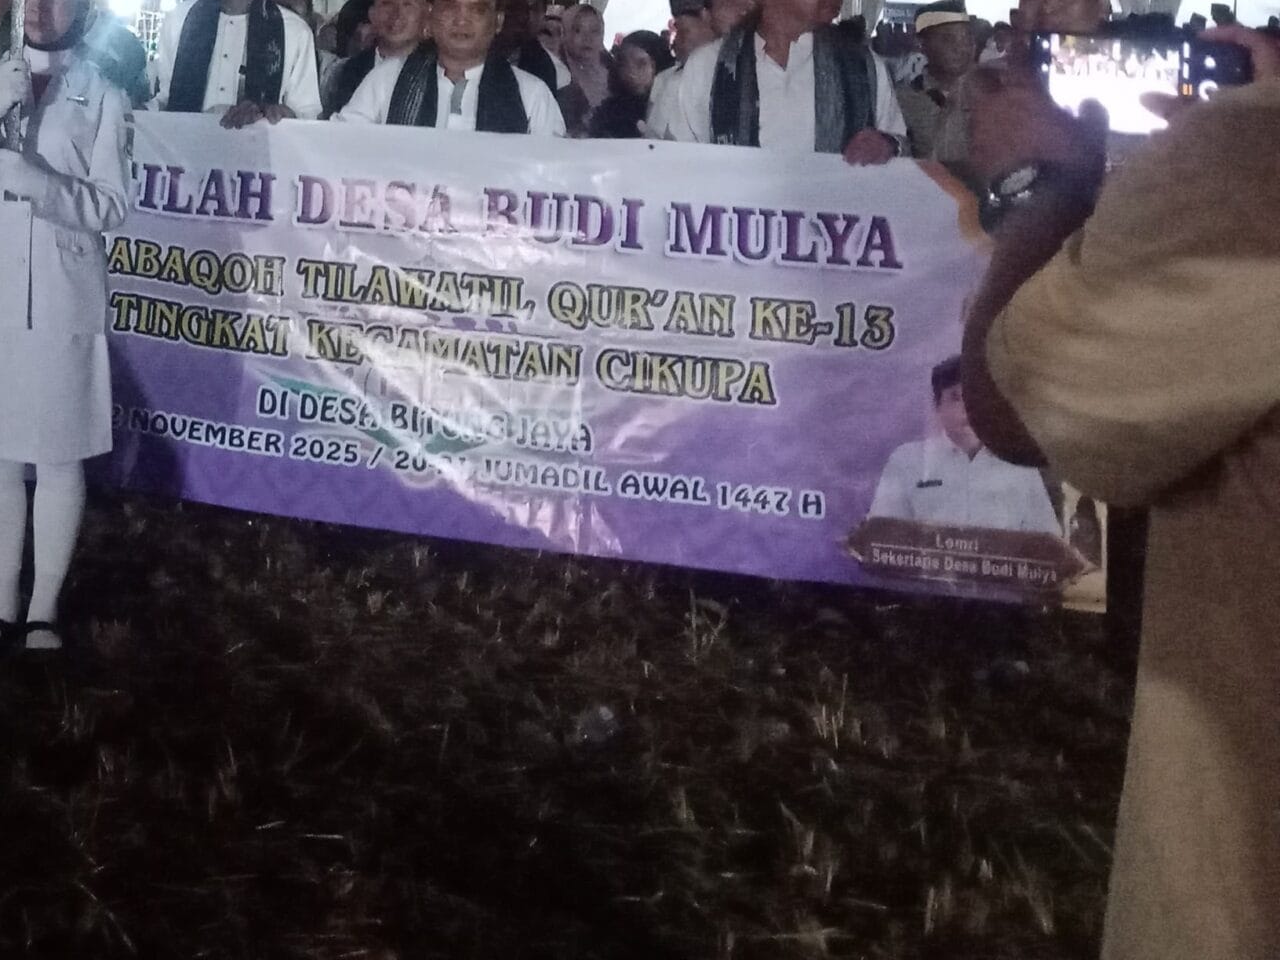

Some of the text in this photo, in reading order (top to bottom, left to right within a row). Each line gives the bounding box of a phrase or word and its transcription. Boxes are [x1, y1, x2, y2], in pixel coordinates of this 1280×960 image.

[133, 161, 903, 270] ILAH DESA BUDI MULYA
[110, 292, 290, 357] TINGKAT
[596, 348, 776, 405] CIKUPA
[296, 258, 536, 321] TILAWATIL
[748, 296, 896, 350] KE-13
[131, 408, 283, 454] NOVEMBER
[292, 436, 359, 464] 2025
[369, 445, 384, 465] /
[481, 457, 608, 493] JUMADIL
[620, 473, 707, 503] AWAL
[719, 483, 789, 510] 1447
[801, 492, 824, 515] H
[259, 387, 287, 418] DI
[299, 392, 379, 430] DESA
[515, 416, 593, 452] JAYA
